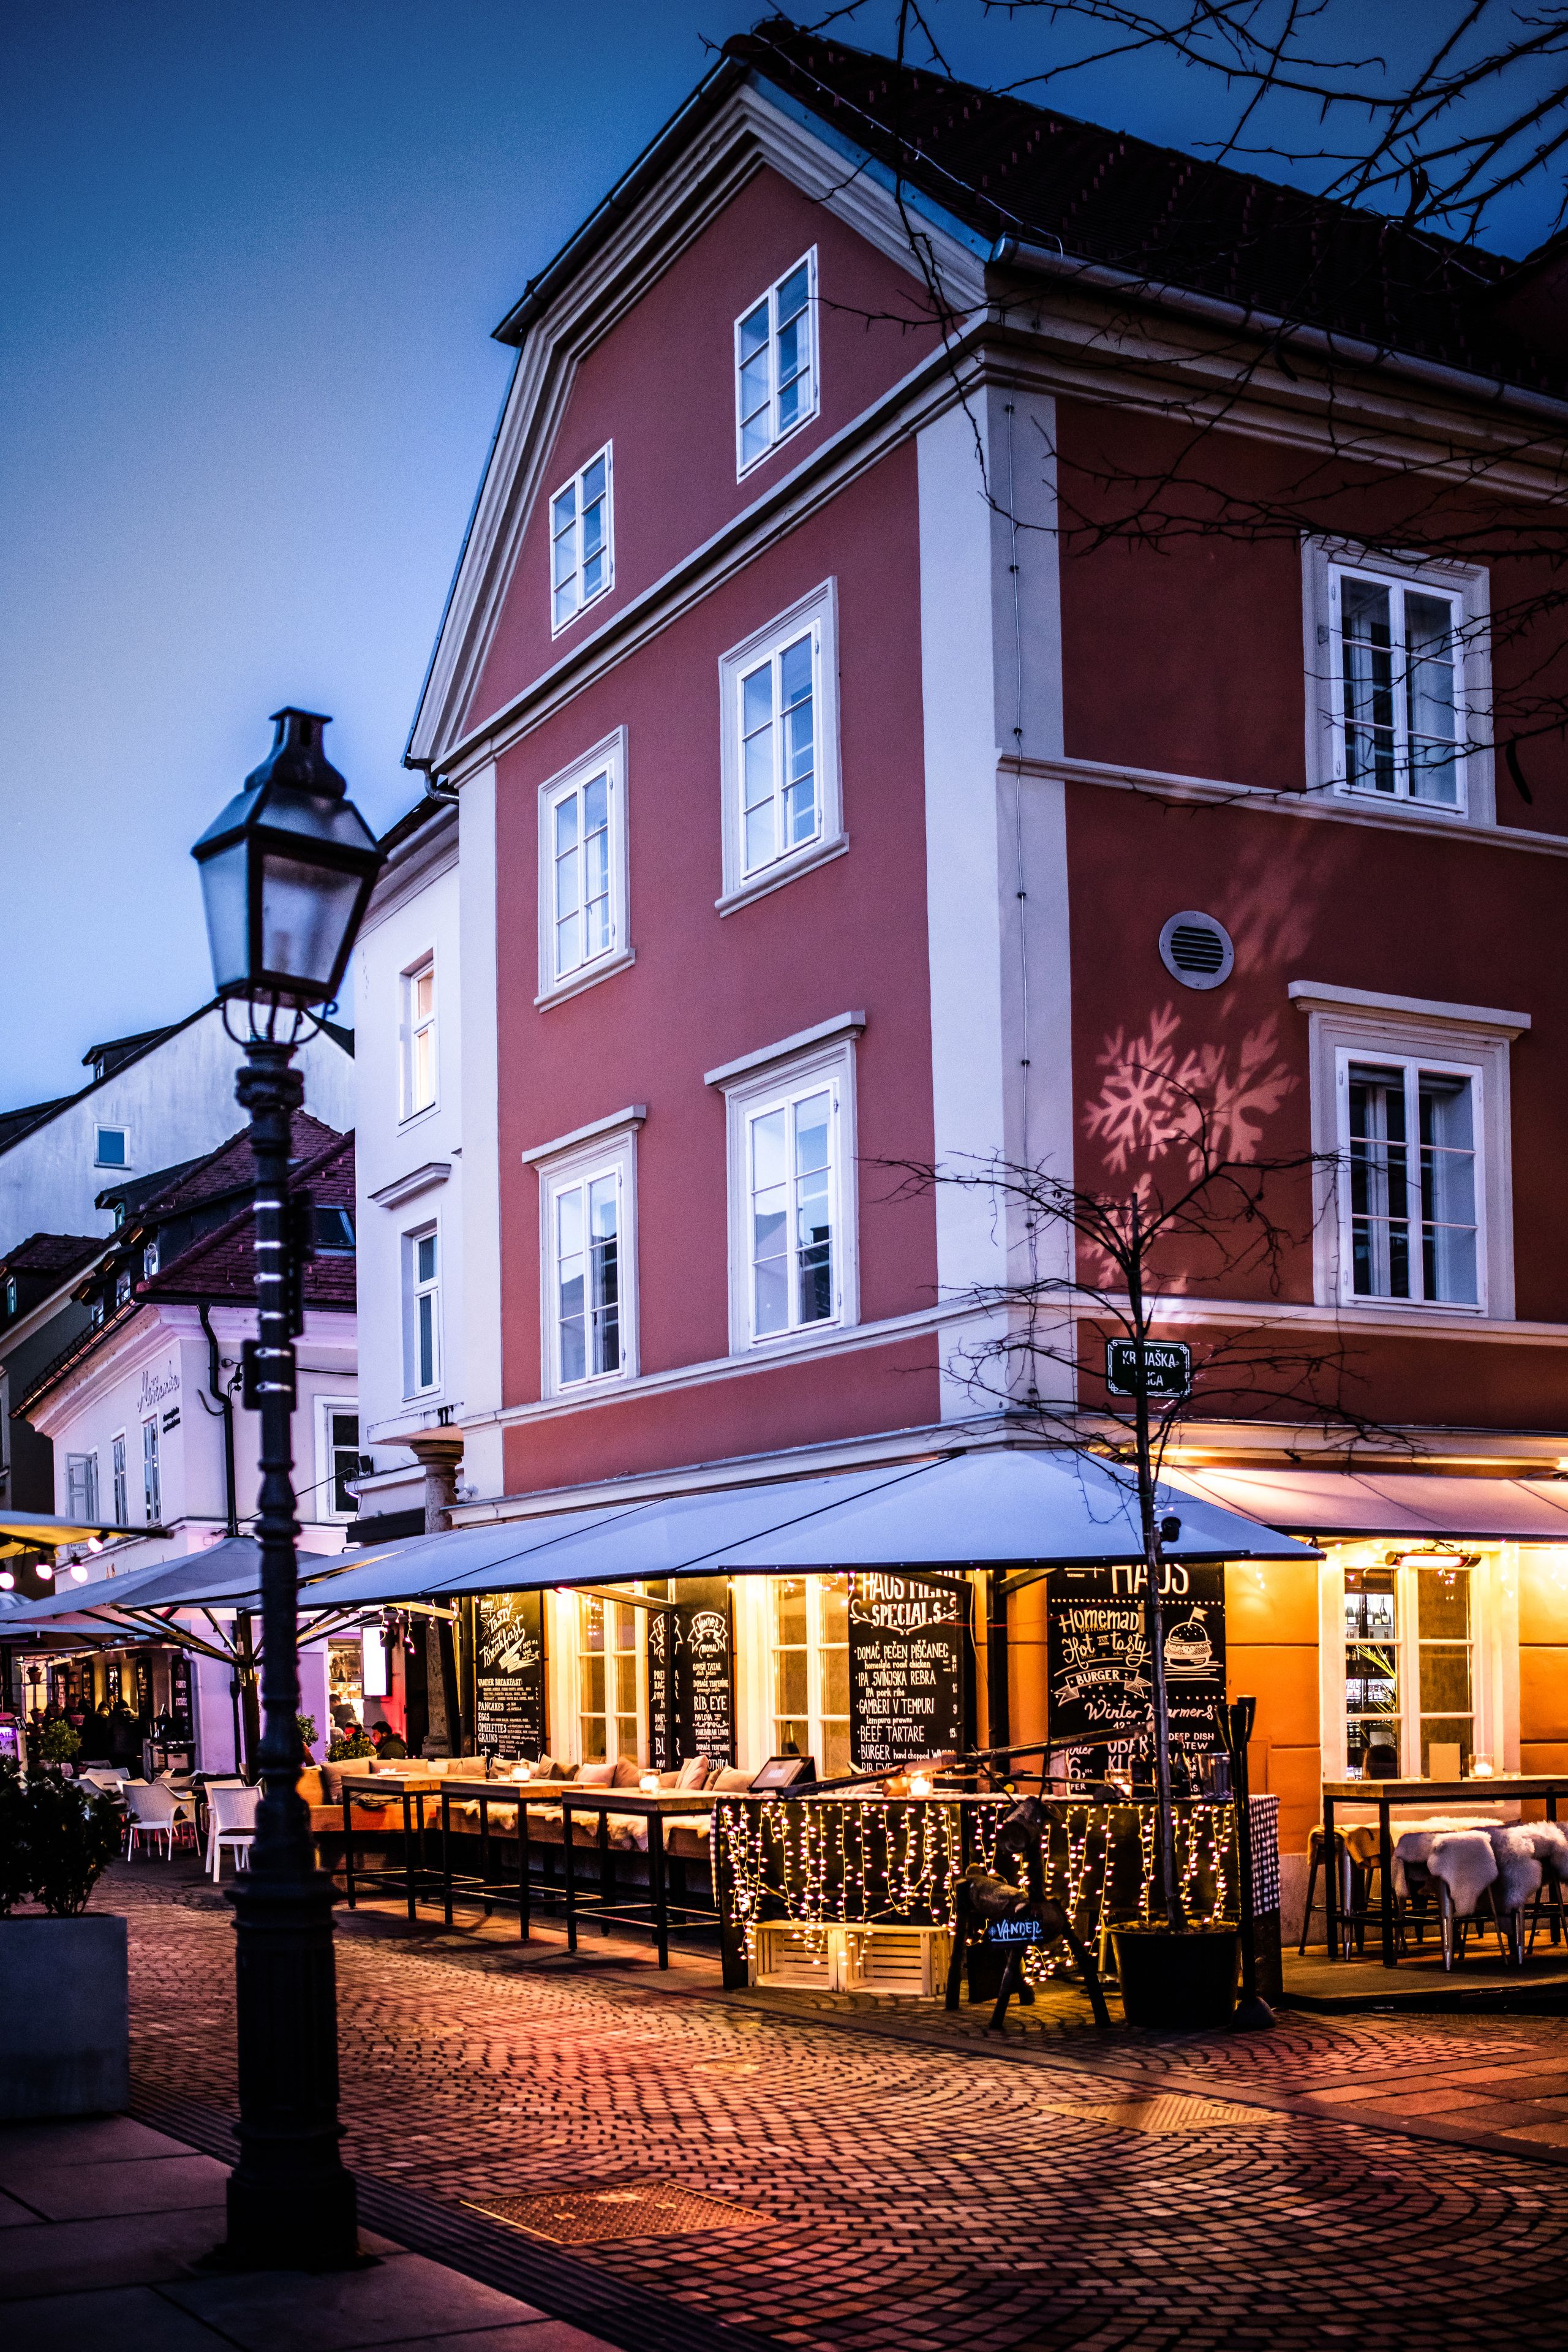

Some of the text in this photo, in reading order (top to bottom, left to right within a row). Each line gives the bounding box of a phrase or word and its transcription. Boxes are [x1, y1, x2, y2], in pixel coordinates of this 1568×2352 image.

[1122, 1349, 1176, 1368] KRJAŠKA
[862, 1572, 904, 1601] HAUS
[857, 1641, 880, 1660] DOMAČ
[883, 1641, 908, 1659] PEČEN
[911, 1639, 949, 1659] PIŠČANEC
[1061, 1634, 1096, 1670] Hot
[1110, 1631, 1152, 1667] tasty
[864, 1659, 931, 1671] homestyle roast chicken
[858, 1672, 869, 1687] IPA
[910, 1670, 937, 1686] REBRA
[1076, 1669, 1120, 1686] BURGER
[865, 1687, 905, 1698] IPA pork ribs
[478, 1702, 504, 1711] PANCAKES
[693, 1694, 728, 1711] RIB EYE
[859, 1698, 890, 1714] GAMBERI
[892, 1699, 899, 1714] V
[901, 1698, 935, 1714] TEMPURI
[1084, 1699, 1142, 1721] Winter
[478, 1713, 490, 1722] EGGS
[866, 1715, 913, 1726] tempura prawns
[478, 1722, 507, 1733] OMELETTES
[861, 1725, 883, 1743] BEEF
[885, 1725, 924, 1742] TARTARE
[478, 1733, 498, 1743] GRAINS
[861, 1744, 891, 1760] BURGER
[893, 1749, 907, 1760] hand
[908, 1749, 930, 1762] chopped
[997, 1919, 1042, 1942] VANDER
